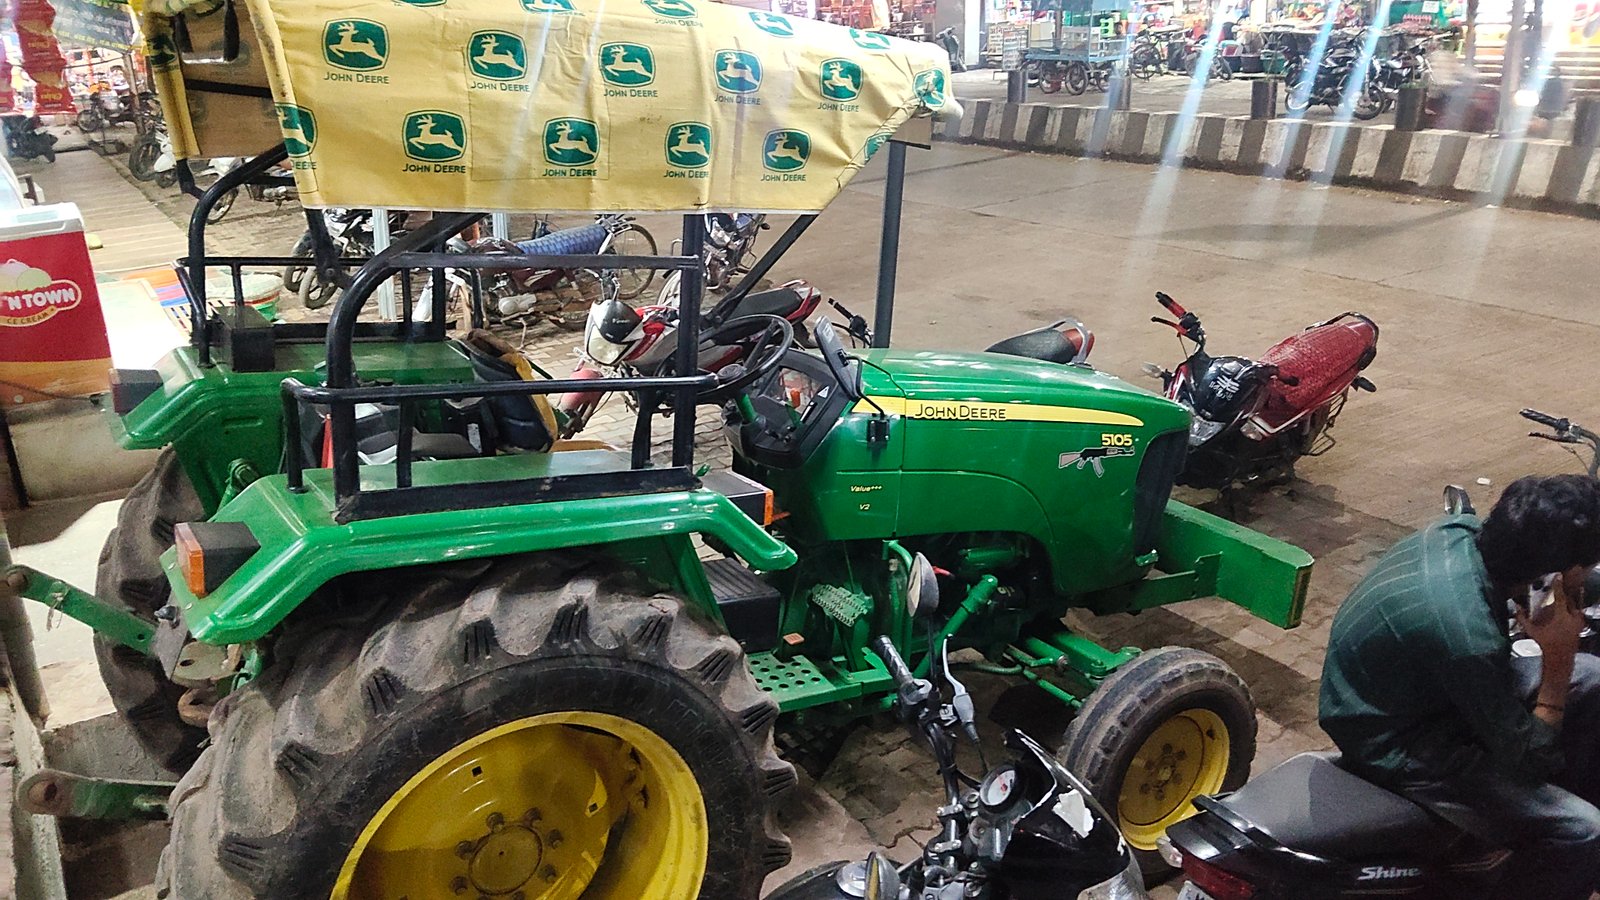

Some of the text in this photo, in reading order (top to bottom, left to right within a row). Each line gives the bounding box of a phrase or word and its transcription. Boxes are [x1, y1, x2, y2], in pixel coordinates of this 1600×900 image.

[323, 72, 389, 84] JOHN DEERE
[470, 81, 530, 92] JOHN DEERE
[603, 88, 658, 98] JOHN DEERE
[714, 94, 761, 105] JOHN DEERE
[817, 102, 838, 111] JOHN
[402, 163, 466, 174] JOHN DEERE
[542, 168, 597, 177] JOHN DEERE
[663, 169, 686, 178] JOHN
[760, 173, 806, 182] JOHN DEERE
[22, 288, 76, 308] TOWN
[20, 311, 48, 324] CREAM
[914, 404, 1007, 420] JOHN DEERE
[1101, 433, 1133, 447] 5105
[1357, 866, 1420, 880] Shine
